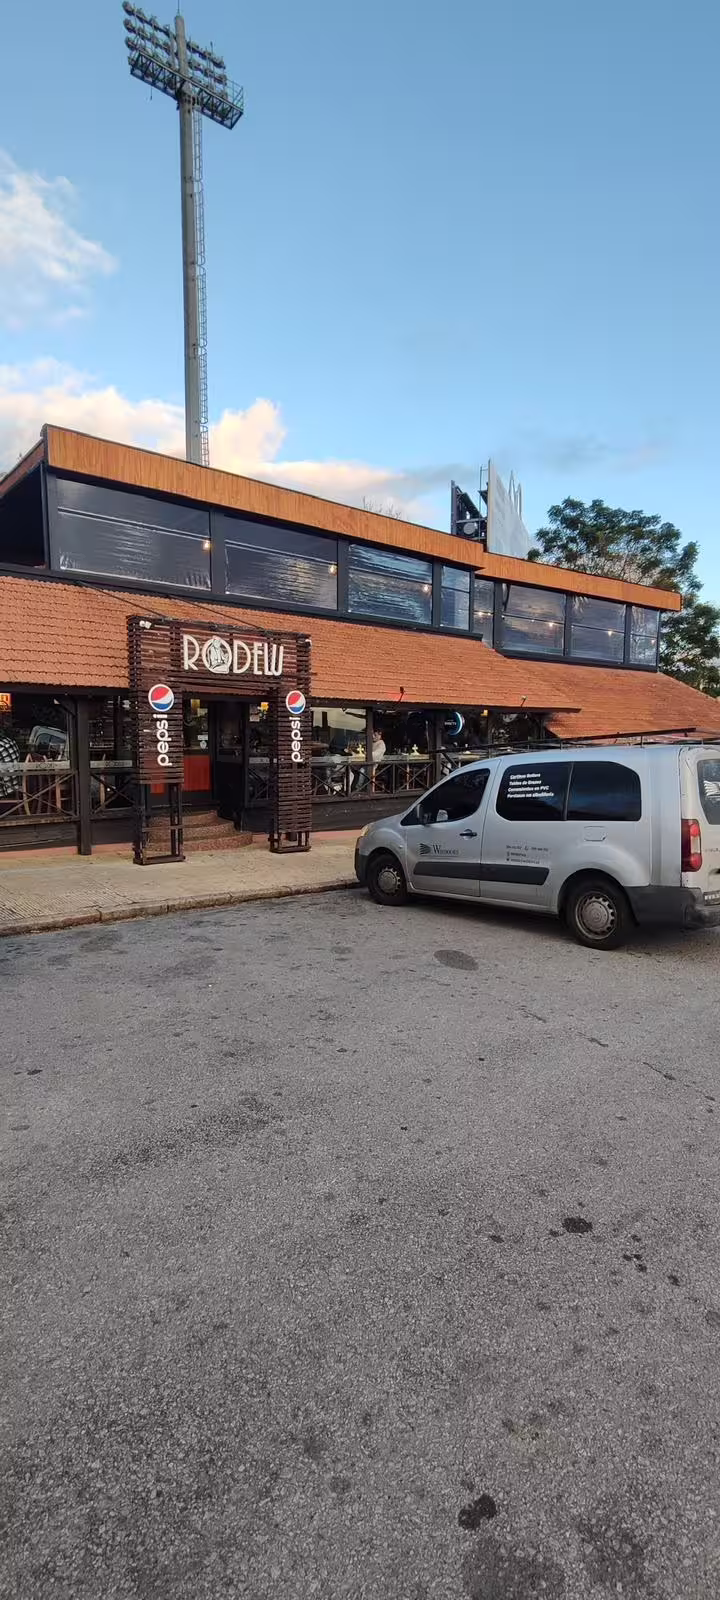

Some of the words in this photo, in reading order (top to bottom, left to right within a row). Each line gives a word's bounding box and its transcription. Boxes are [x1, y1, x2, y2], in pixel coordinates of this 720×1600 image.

[183, 634, 284, 676] RODELU
[153, 713, 172, 766] pepsi
[289, 716, 303, 762] pepsi
